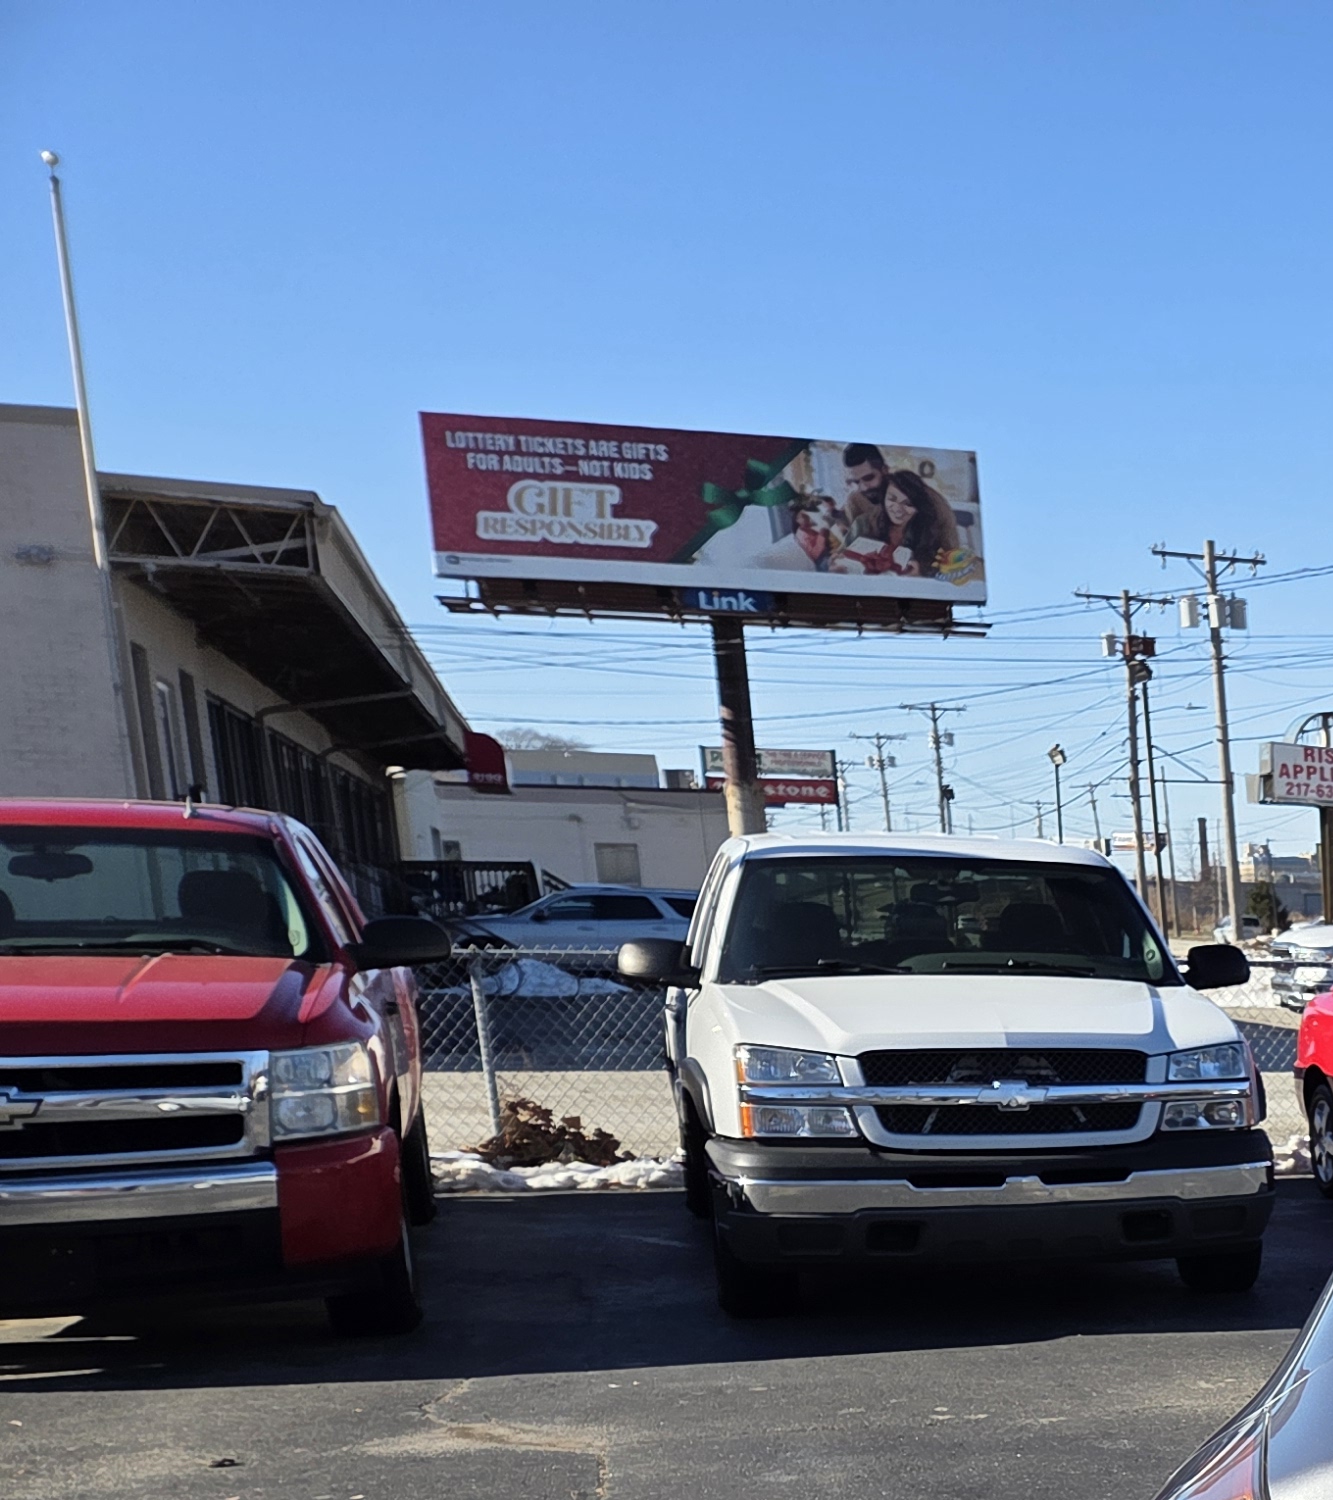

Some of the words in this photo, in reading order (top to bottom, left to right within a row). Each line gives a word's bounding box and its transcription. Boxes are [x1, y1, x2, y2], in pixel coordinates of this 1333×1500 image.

[445, 430, 515, 451] LOTTERY
[517, 435, 587, 455] TICKETS
[588, 439, 620, 458] ARE
[621, 442, 669, 461] GIFTS
[466, 453, 499, 471] FOR
[614, 462, 654, 480] KIDS
[513, 484, 616, 519] GIFT
[483, 516, 651, 542] RESPONSIBLY
[698, 590, 757, 612] Link
